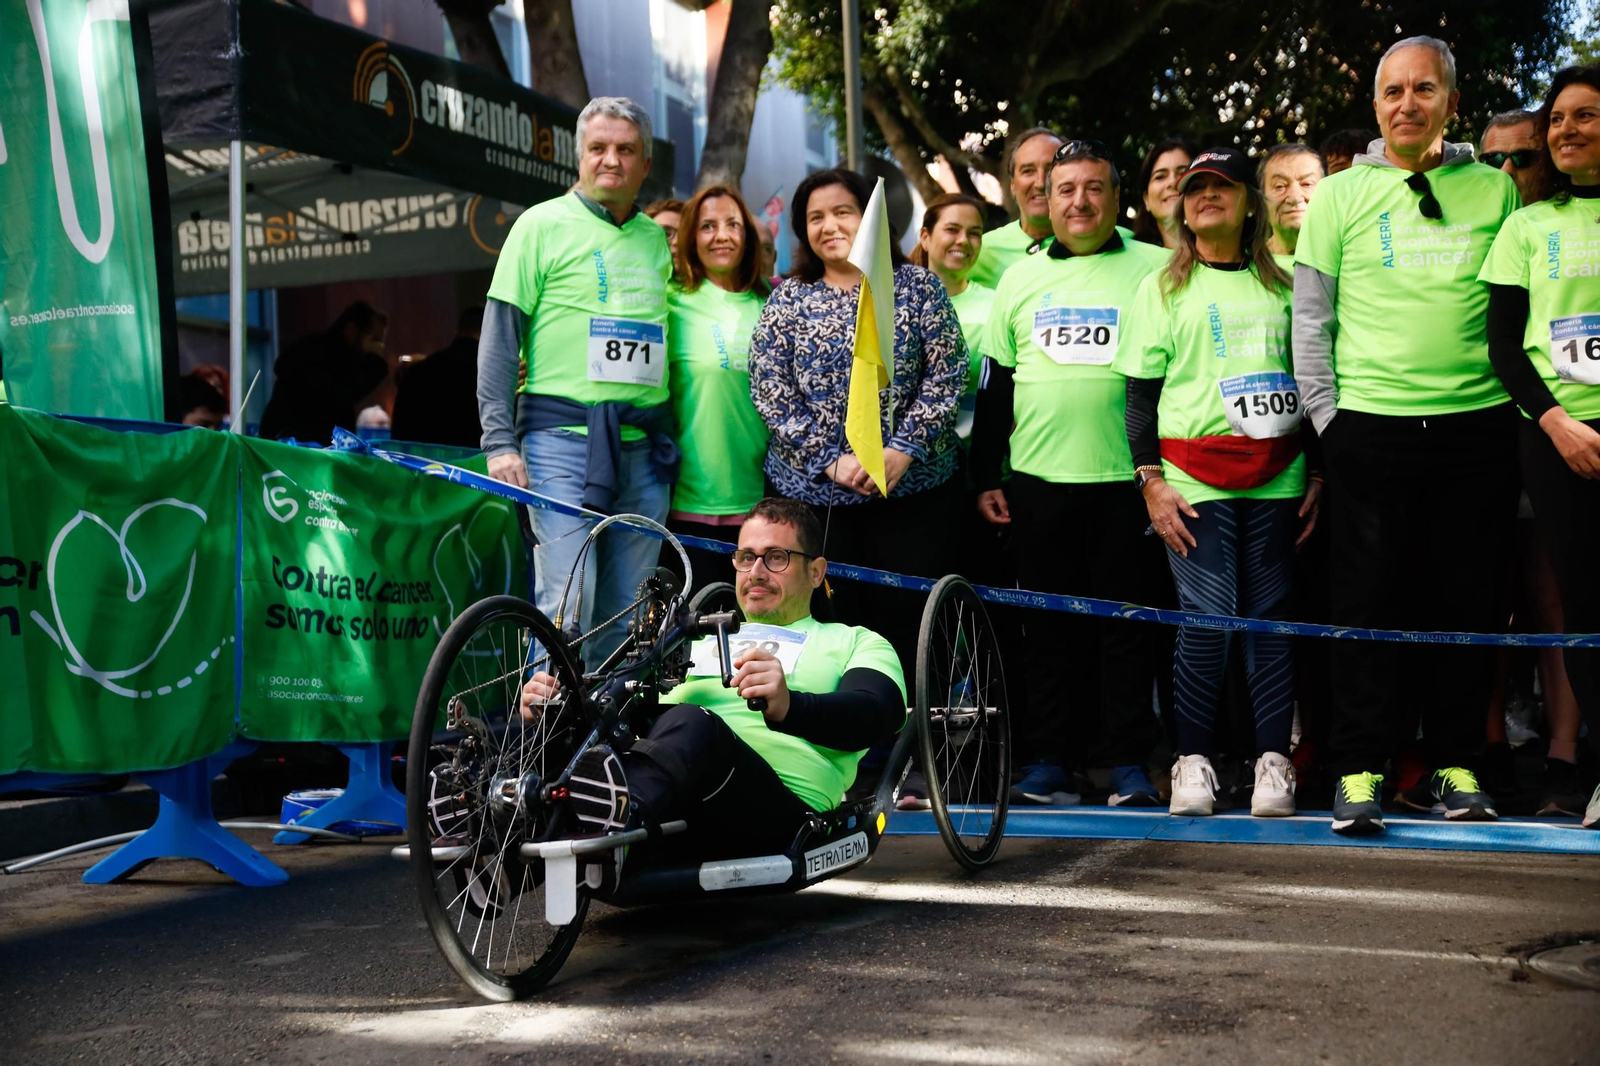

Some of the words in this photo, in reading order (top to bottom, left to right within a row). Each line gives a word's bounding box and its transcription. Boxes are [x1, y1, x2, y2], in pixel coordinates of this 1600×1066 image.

[486, 147, 557, 184] cronometraje
[1376, 211, 1395, 268] ALMERÍA
[1395, 225, 1413, 235] En
[1417, 223, 1472, 234] marcha
[1398, 235, 1453, 248] contra
[1457, 231, 1472, 246] el
[1399, 248, 1475, 267] cáncer
[1546, 229, 1561, 279] ALMERÍA
[1564, 249, 1599, 259] con
[592, 250, 608, 303] ALMERÍA
[1563, 259, 1600, 278] cán
[1040, 326, 1110, 346] 1520
[1206, 302, 1227, 358] ALMERÍA
[1554, 327, 1578, 335] contra
[605, 340, 650, 364] 871
[1562, 337, 1600, 363] 16
[1233, 391, 1298, 419] 1509
[355, 571, 377, 602] el
[377, 574, 435, 605] cáncer
[351, 608, 389, 641] solo
[393, 614, 429, 640] uno
[269, 675, 290, 686] 900
[292, 677, 309, 686] 100
[807, 837, 867, 874] TETRATEAM
